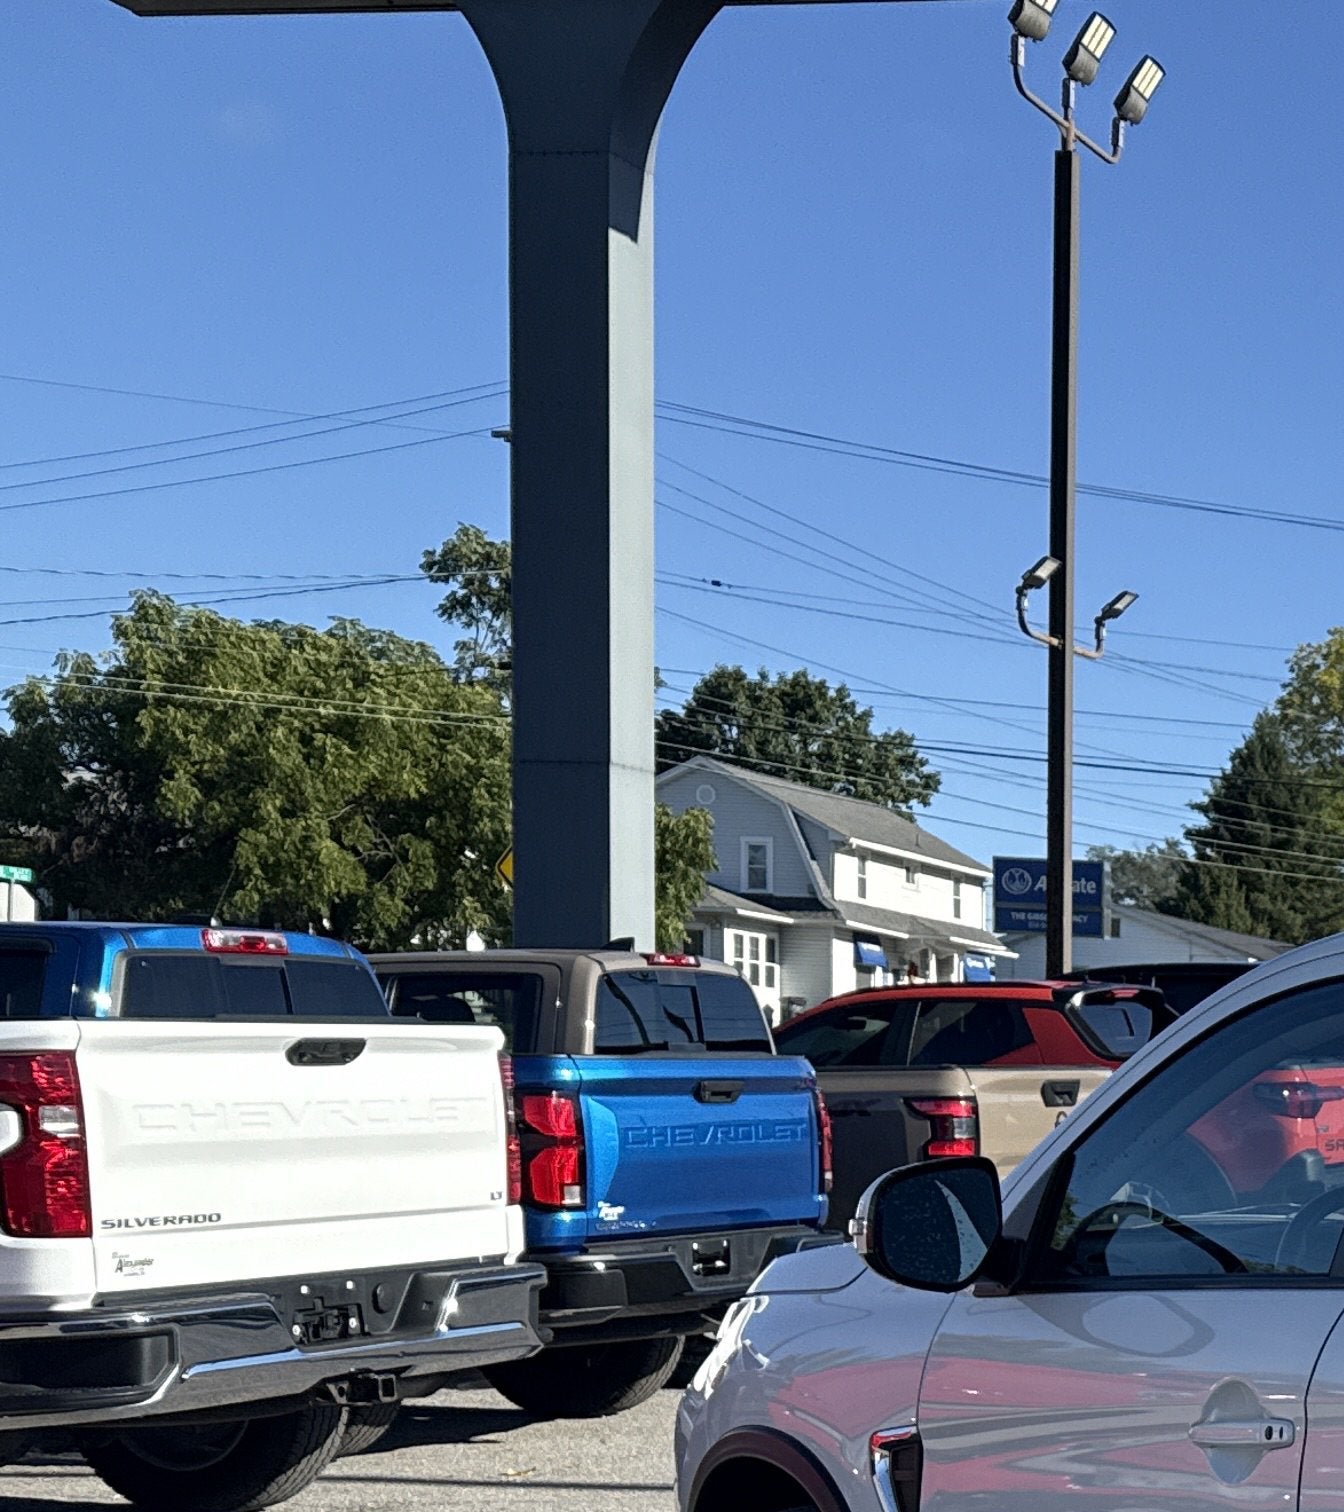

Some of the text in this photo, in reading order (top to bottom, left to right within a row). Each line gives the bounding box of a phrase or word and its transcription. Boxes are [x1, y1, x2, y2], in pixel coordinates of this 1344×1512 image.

[132, 1097, 487, 1132] CHEVROLET
[624, 1122, 807, 1149] CHEVROLET
[101, 1213, 221, 1229] SILVERADO
